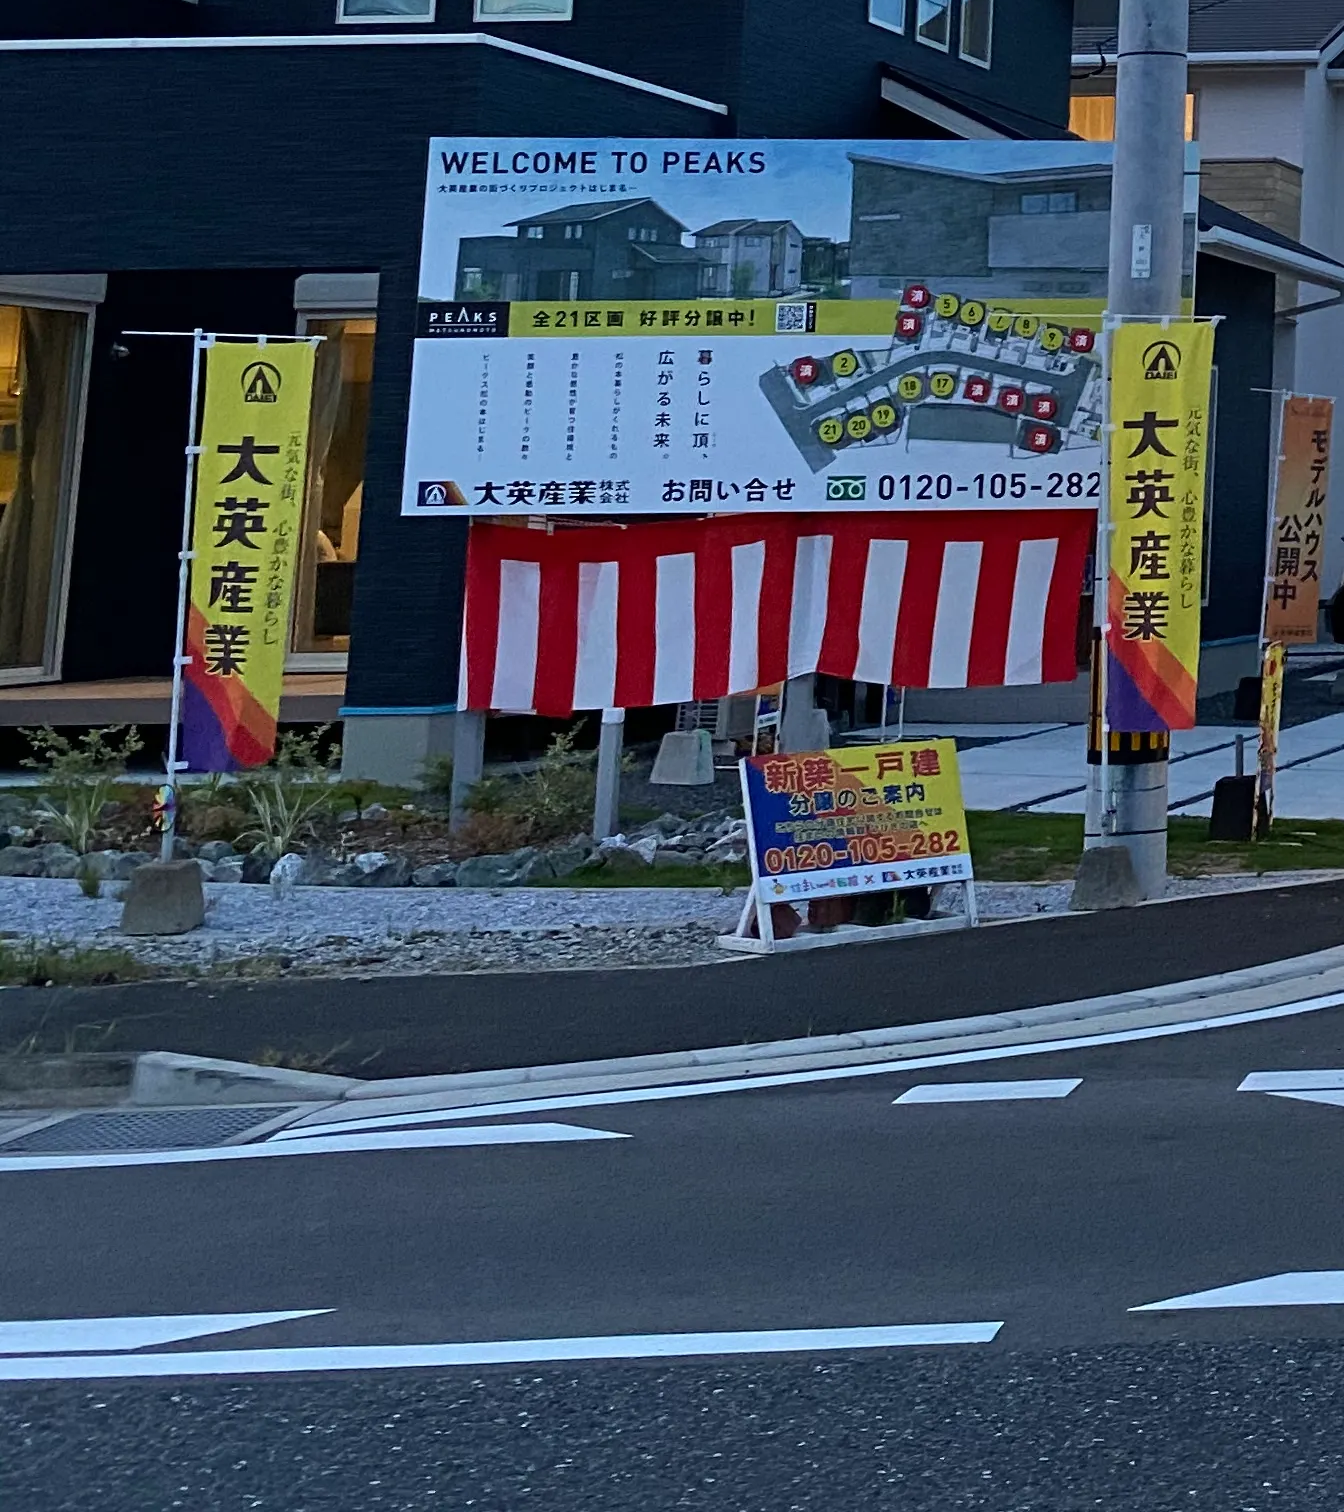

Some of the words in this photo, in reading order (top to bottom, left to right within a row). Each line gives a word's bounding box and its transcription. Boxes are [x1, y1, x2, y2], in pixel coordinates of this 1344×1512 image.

[441, 151, 598, 174] WELCOME
[611, 151, 648, 174] TO
[663, 151, 766, 174] PEAKS
[429, 307, 497, 323] PEAKS
[532, 310, 625, 328] 全21区画
[904, 381, 917, 391] 18
[936, 378, 949, 388] 17
[851, 420, 866, 431] 20
[877, 409, 890, 420] 19
[823, 424, 837, 435] 21
[661, 477, 796, 503] お問い合せ
[878, 472, 1101, 501] 0120-105-282
[1300, 430, 1328, 583] モデルハウス
[1122, 411, 1180, 641] 大英産業
[204, 436, 280, 676] 大英産業
[1273, 514, 1300, 610] 公開中
[763, 748, 941, 793] 新築一戸建
[765, 830, 962, 875] 0120-105-282
